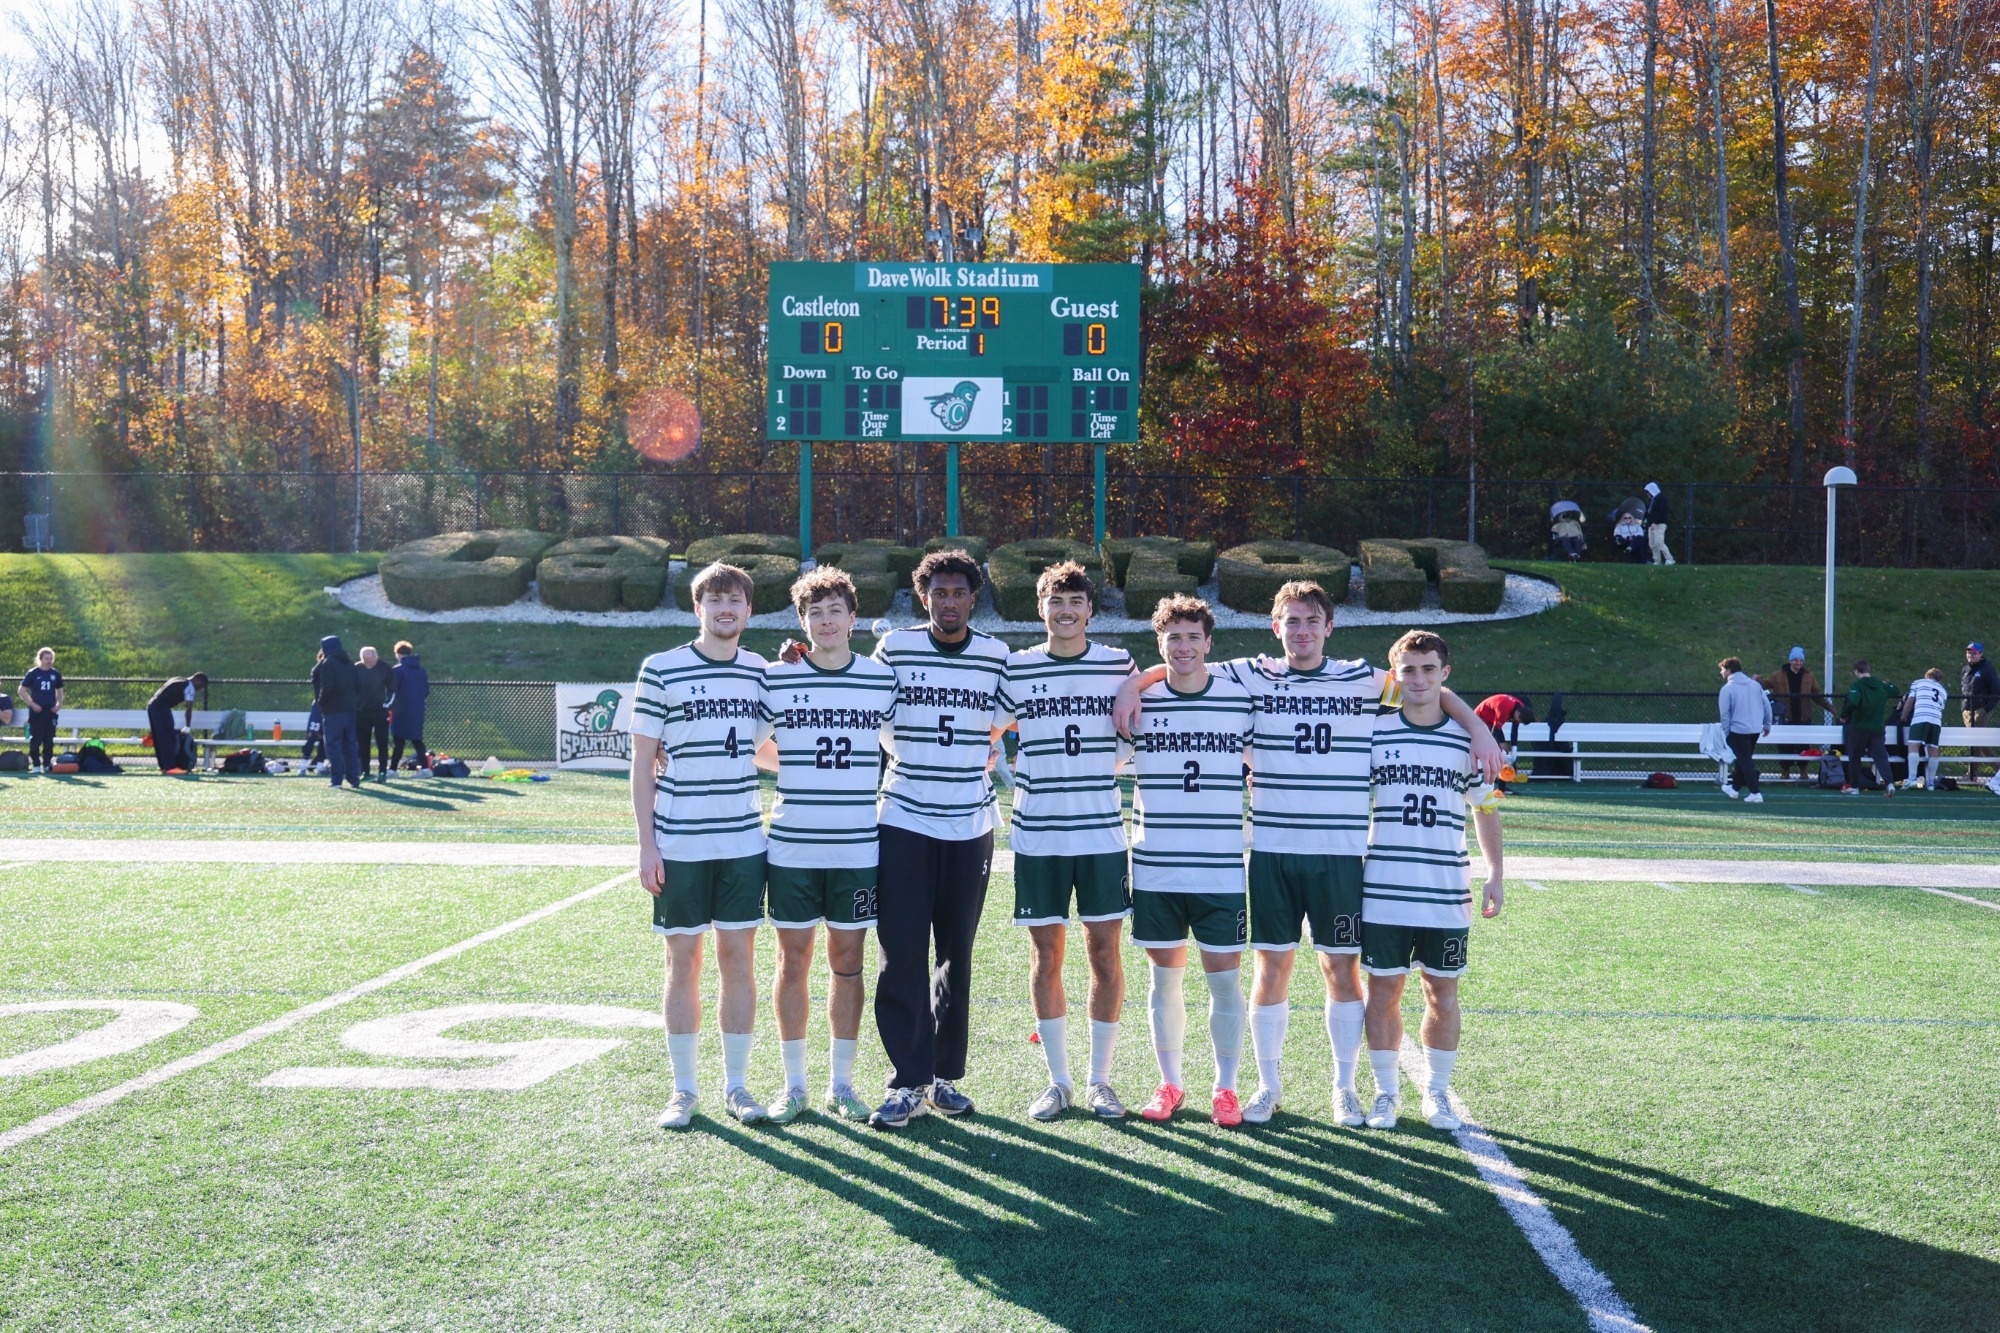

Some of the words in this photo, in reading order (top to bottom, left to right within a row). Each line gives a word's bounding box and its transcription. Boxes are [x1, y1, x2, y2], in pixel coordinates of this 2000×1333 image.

[867, 267, 909, 288] Dave
[909, 267, 952, 287] Wolk
[957, 267, 1039, 288] Stadium
[782, 295, 860, 317] Castleton
[932, 297, 999, 327] 7:39
[1050, 296, 1119, 319] Guest
[824, 322, 842, 353] 0
[916, 335, 967, 350] Period
[979, 333, 985, 354] 1
[1088, 324, 1105, 354] 0
[783, 365, 827, 378] Down
[852, 366, 872, 379] To
[875, 366, 898, 379] Go
[1072, 368, 1102, 381] Ball
[1106, 368, 1130, 381] On
[776, 389, 784, 403] 1
[1003, 391, 1011, 405] 1
[776, 416, 786, 431] 2
[862, 411, 889, 421] Time
[862, 420, 887, 429] Outs
[1002, 418, 1012, 433] 2
[1090, 413, 1117, 422] Time
[1090, 421, 1115, 431] Outs
[862, 427, 883, 437] Left
[1090, 429, 1111, 439] Left
[41, 681, 51, 690] 21
[1931, 688, 1940, 702] 3
[905, 686, 989, 712] SPARTANS
[1263, 694, 1363, 716] SPARTANS
[682, 698, 758, 722] SPARTAN
[784, 709, 880, 730] SPARTANS
[937, 715, 955, 747] 5
[1064, 724, 1081, 757] 6
[1294, 723, 1332, 755] 20
[724, 726, 739, 759] 4
[816, 736, 852, 769] 22
[1144, 732, 1237, 754] SPARTANS
[575, 750, 622, 758] SOCCER
[1183, 760, 1200, 793] 2
[1402, 793, 1437, 828] 26
[982, 859, 988, 875] 5
